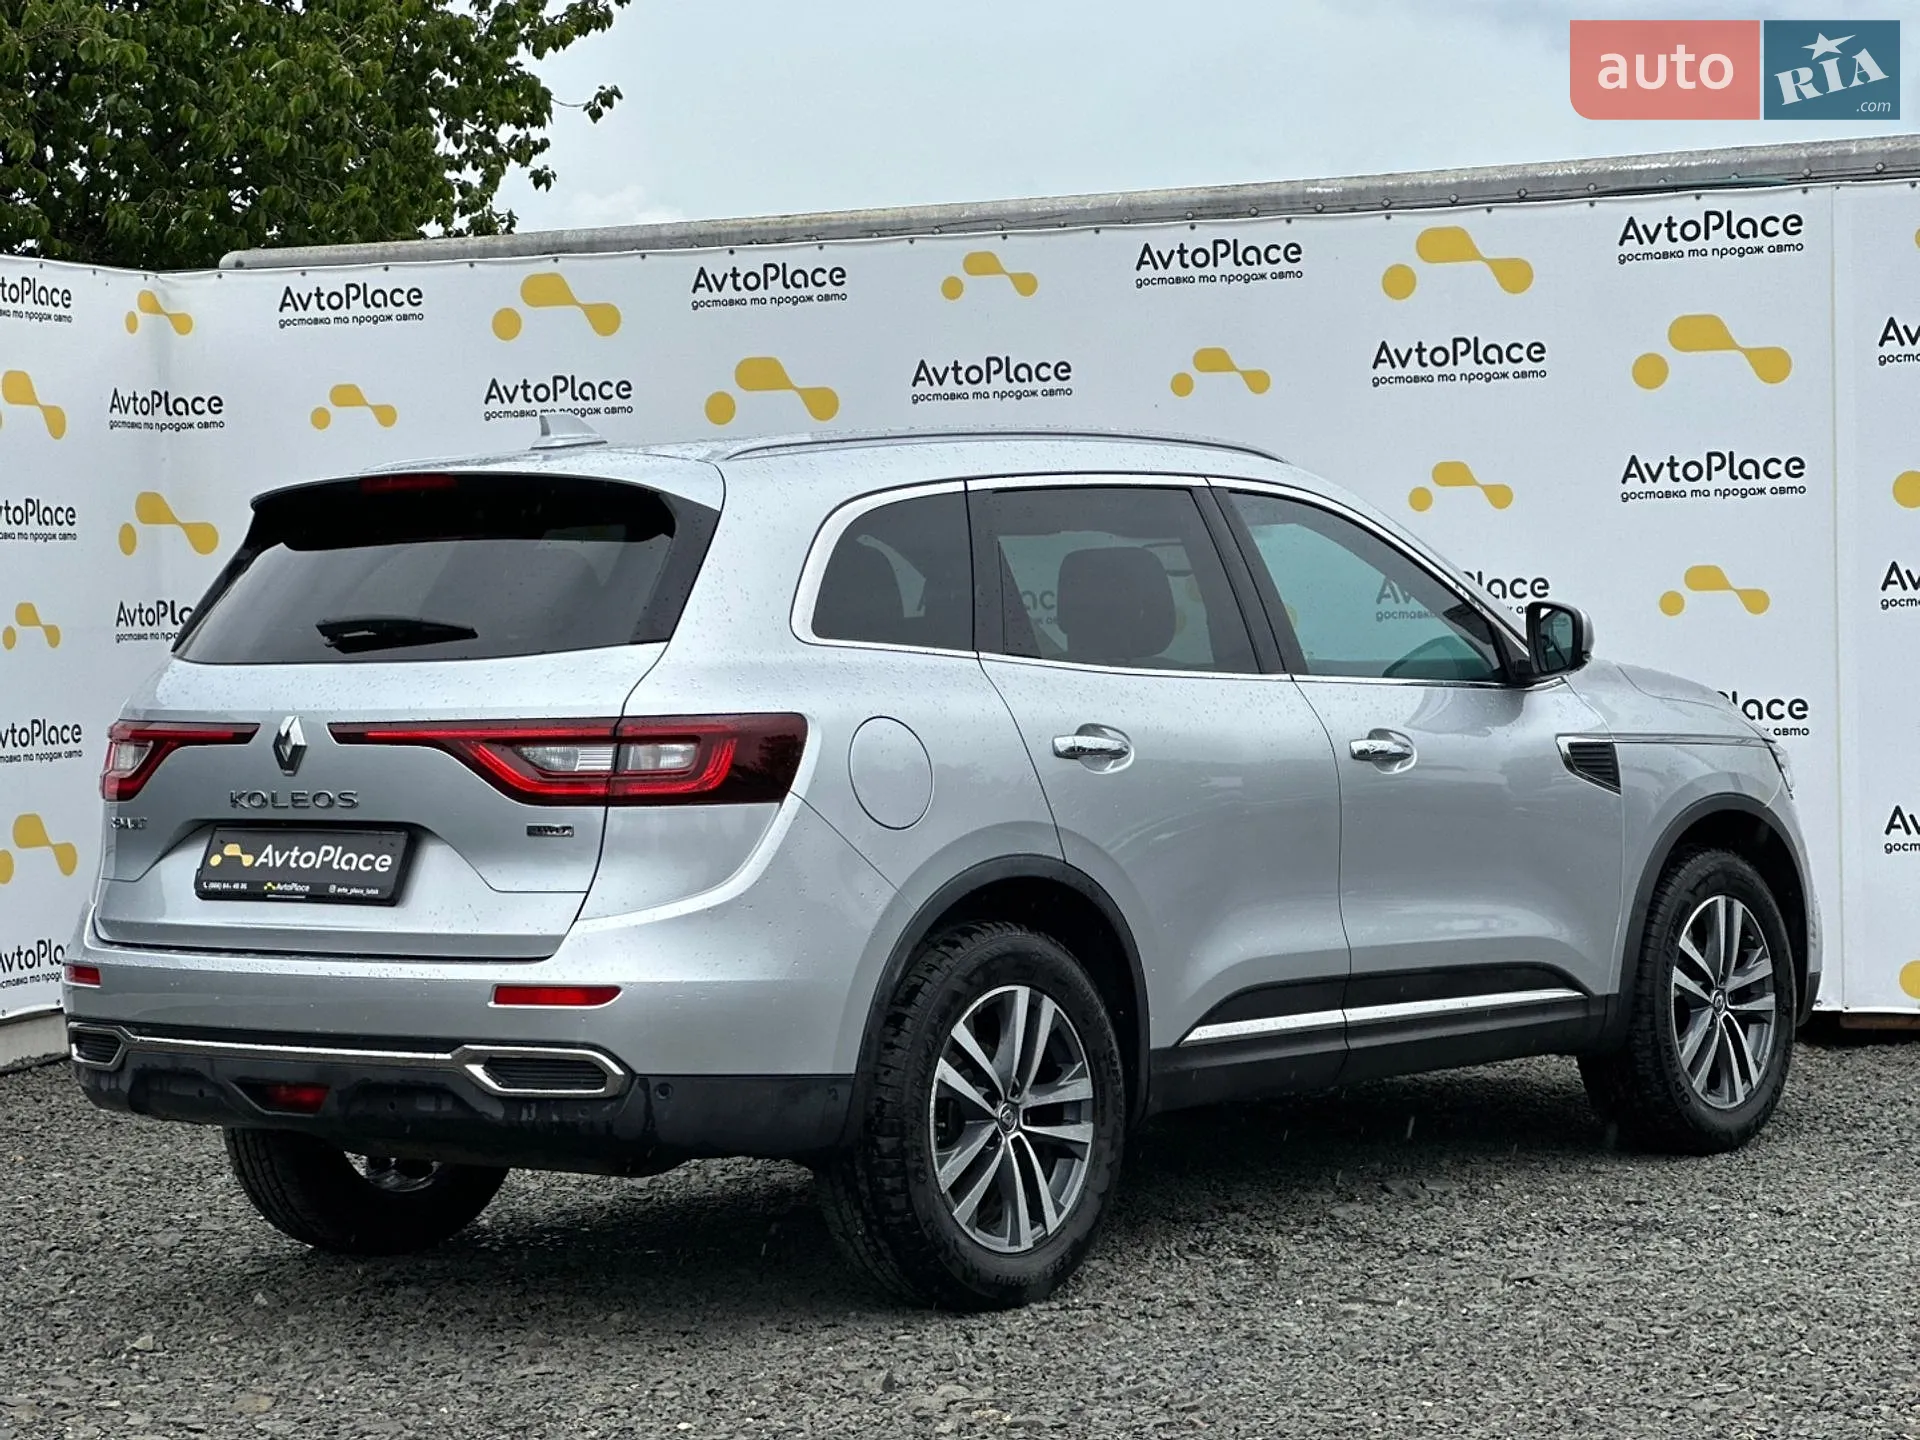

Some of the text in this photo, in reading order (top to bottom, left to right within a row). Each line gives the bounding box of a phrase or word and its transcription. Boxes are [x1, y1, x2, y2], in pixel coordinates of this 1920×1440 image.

[1618, 209, 1804, 247] AvtoPlace
[1135, 238, 1303, 271] AvtoPlace
[1617, 242, 1804, 265] доставка та продаж авто
[0, 276, 72, 309] toPlace
[691, 262, 847, 294] AvtoPlace
[1135, 269, 1303, 289] доставка та продаж авто
[279, 282, 423, 312] AvtoPlace
[691, 292, 848, 311] доставка та продаж авто
[278, 312, 424, 329] доставка та продаж авто
[1371, 336, 1547, 370] AvtoPlace
[911, 355, 1072, 387] AvtoPlace
[1371, 369, 1547, 388] доставка та продаж авто
[109, 387, 223, 416] AvtoPlace
[484, 374, 633, 405] AvtoPlace
[911, 387, 1073, 404] доставка та продаж авто
[484, 409, 537, 421] доставка
[604, 405, 633, 415] авто
[1621, 450, 1806, 485] AvtoPlace
[1620, 485, 1807, 503] доставка та продаж авто
[0, 498, 76, 526] toPlace
[115, 600, 193, 627] AvtoPla
[0, 718, 82, 748] vtoPlace
[1773, 727, 1810, 736] авто
[229, 790, 360, 809] KOLEOS
[254, 843, 393, 872] AvtoPlace
[0, 938, 65, 973] vtoPla
